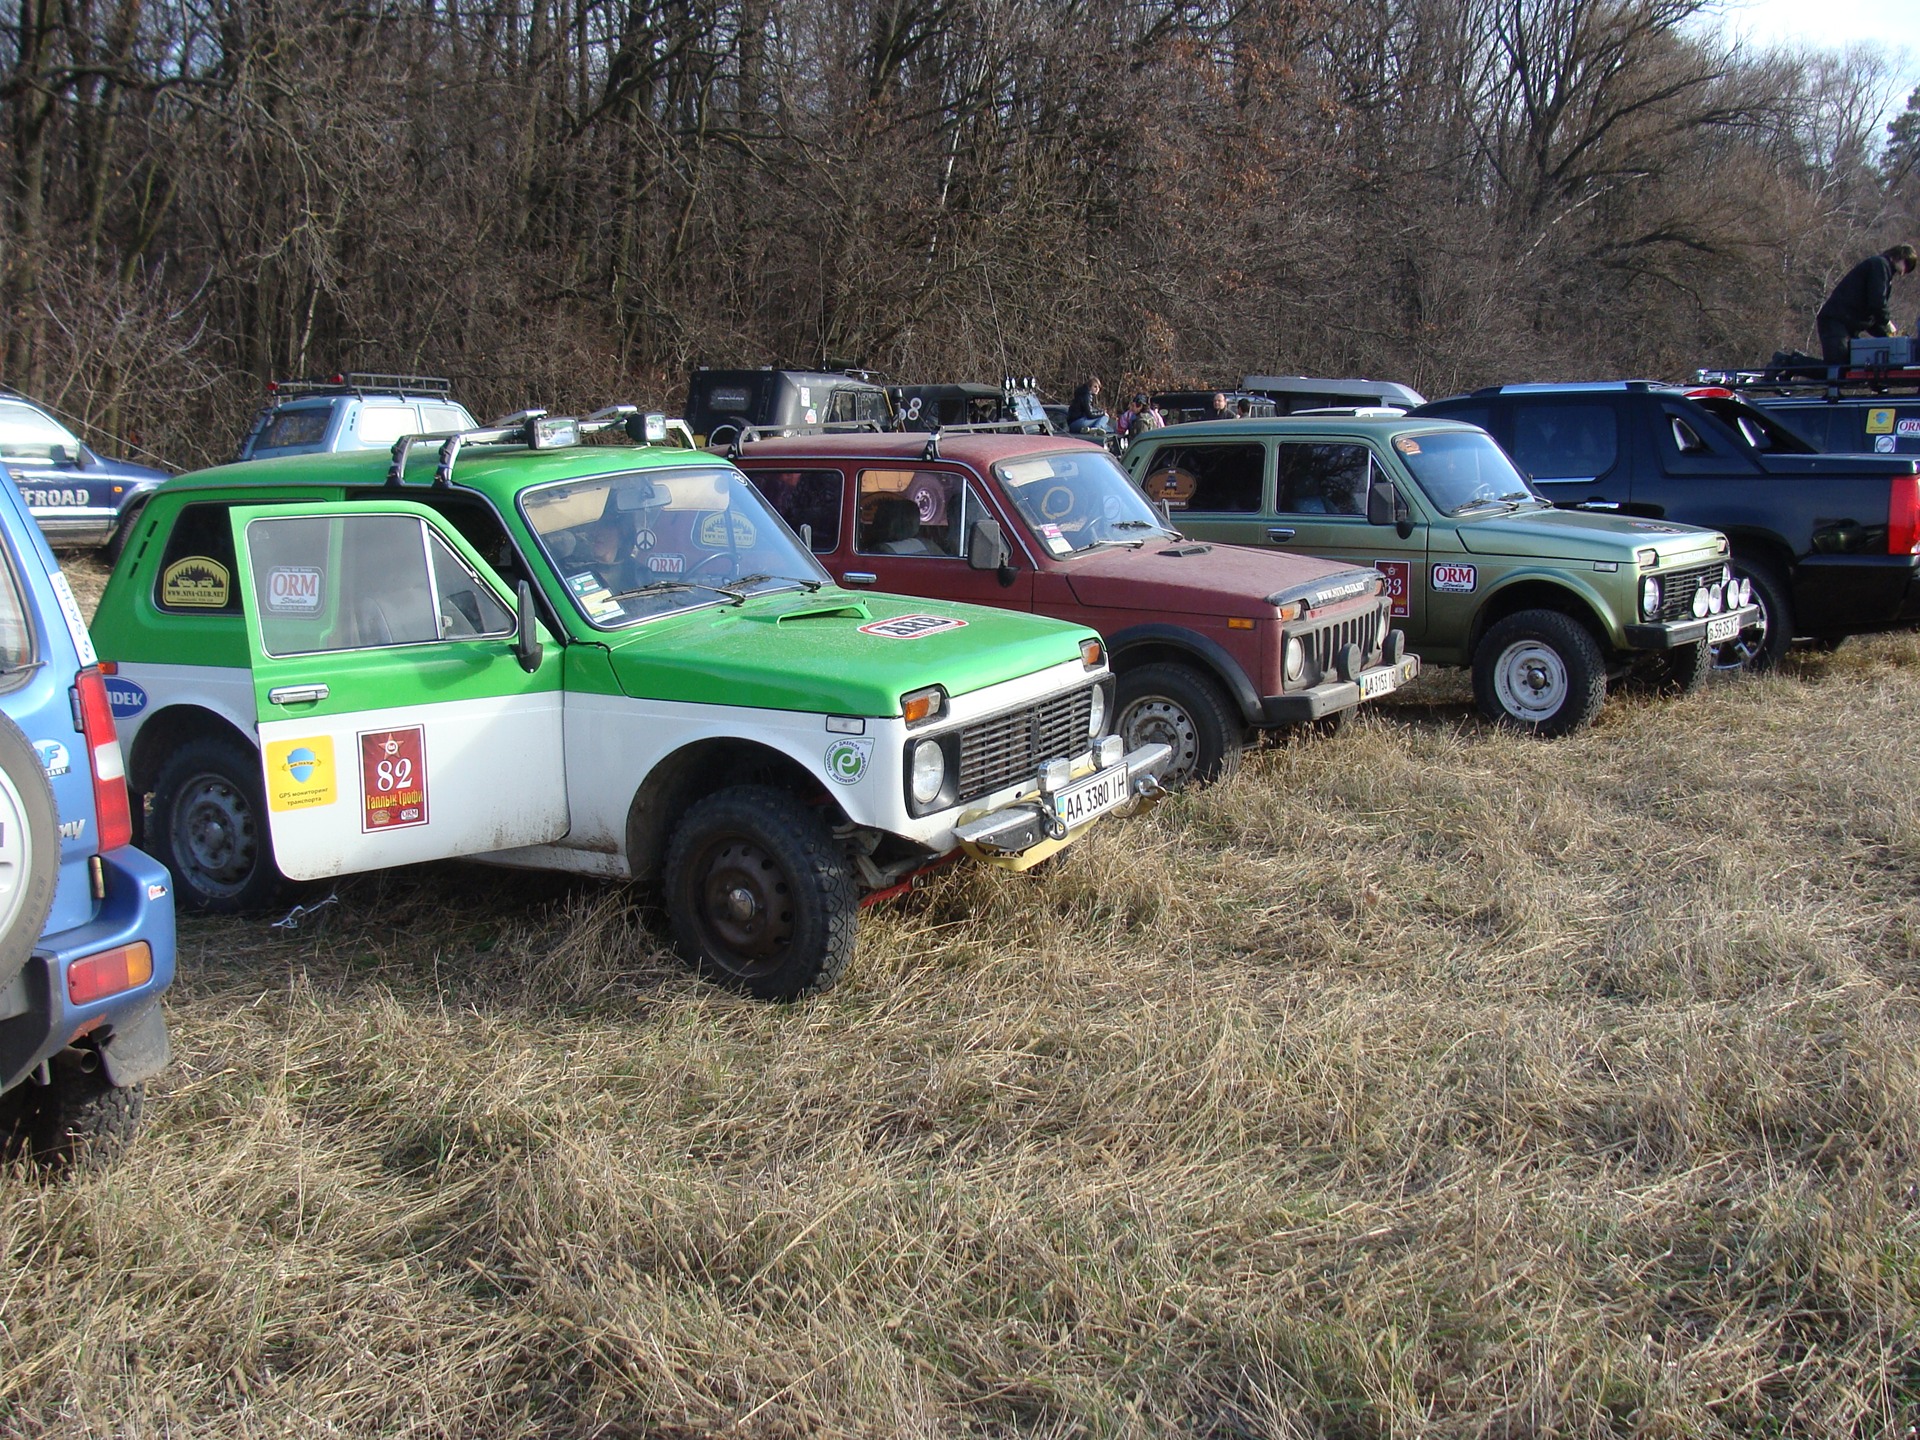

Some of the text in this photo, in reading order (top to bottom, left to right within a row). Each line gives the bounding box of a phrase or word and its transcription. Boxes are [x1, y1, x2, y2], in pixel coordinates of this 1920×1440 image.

[20, 489, 90, 506] FROAD
[650, 558, 681, 572] ORM
[1435, 567, 1472, 583] ORM
[273, 574, 317, 596] ORM
[377, 758, 413, 792] 82
[292, 787, 328, 798] мониторинг
[1066, 772, 1125, 822] AA 3380 IH
